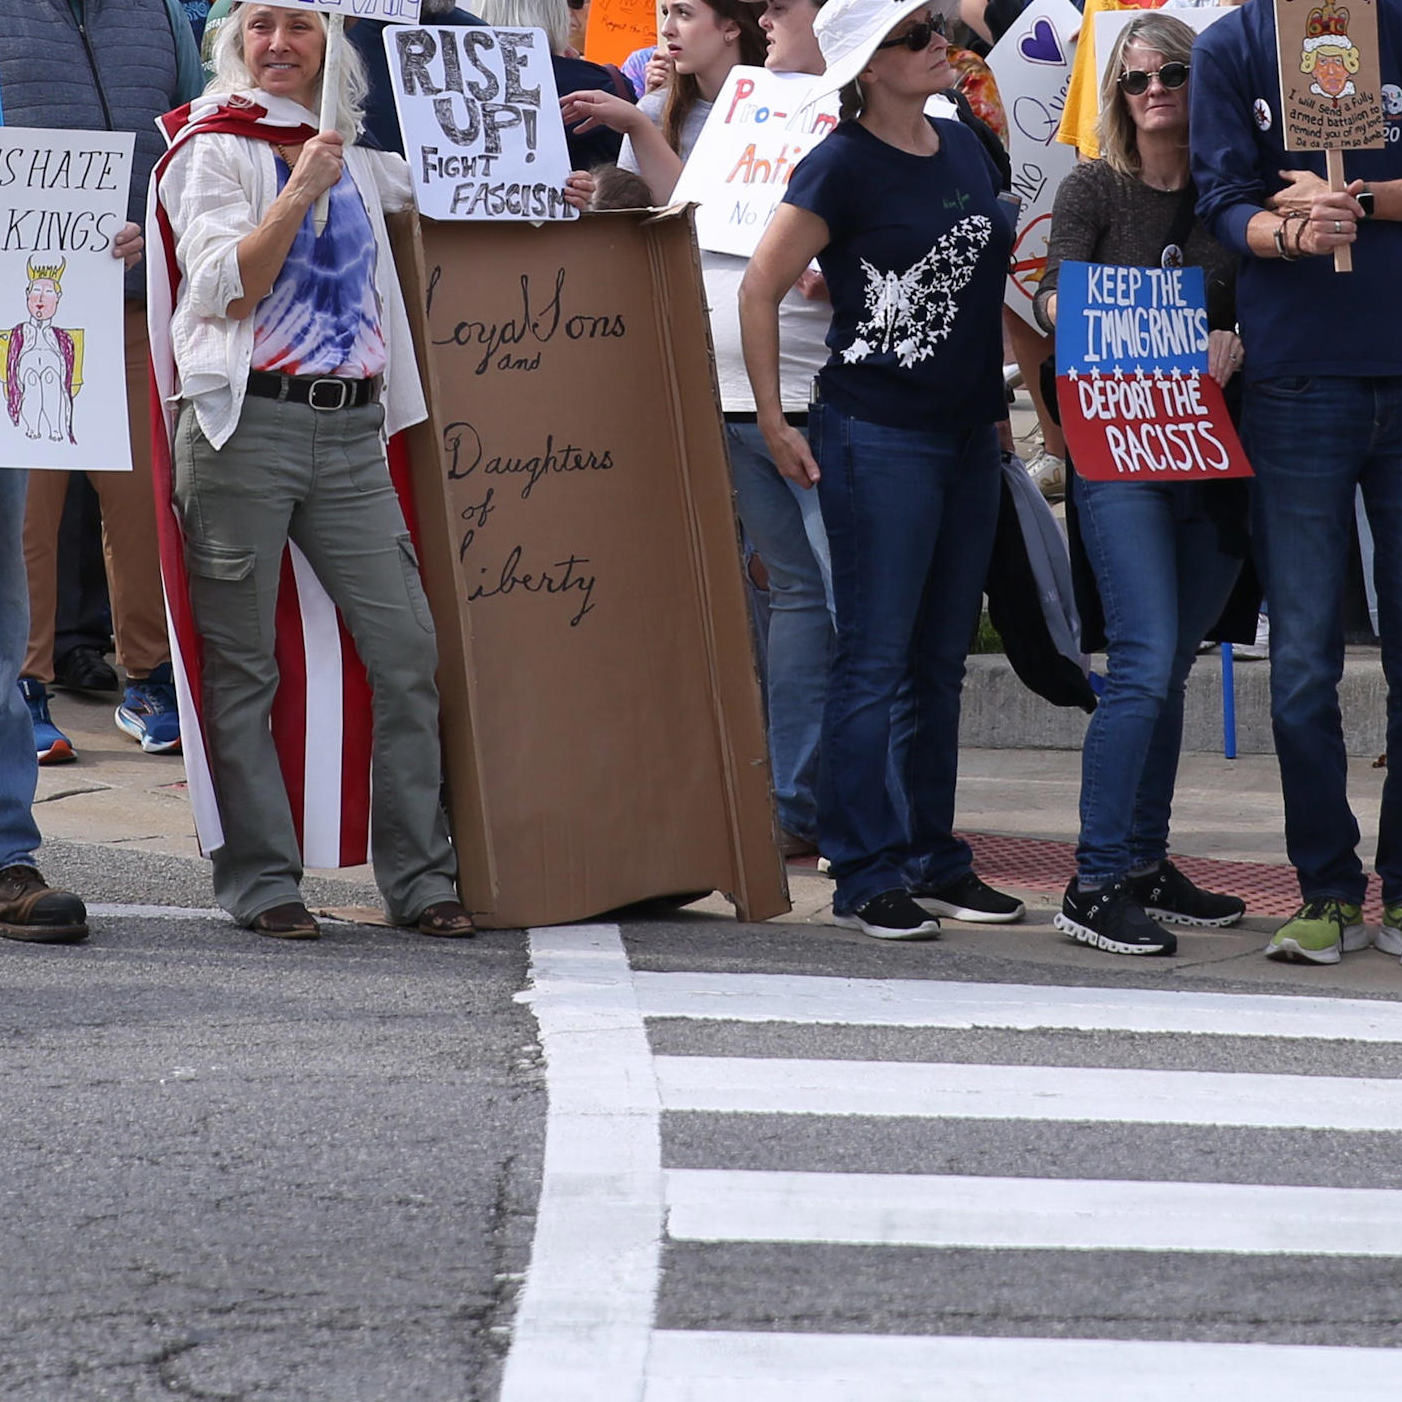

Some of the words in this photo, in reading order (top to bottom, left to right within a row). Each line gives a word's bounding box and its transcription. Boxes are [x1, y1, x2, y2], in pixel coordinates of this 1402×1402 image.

[395, 29, 542, 108] RISE
[725, 78, 838, 135] Pro-Am
[1288, 89, 1296, 100] I
[1298, 98, 1316, 109] will
[1344, 103, 1351, 111] a
[1289, 108, 1323, 126] armed
[1327, 110, 1369, 127] battalion
[1369, 106, 1379, 115] to
[433, 97, 538, 164] UP!
[1289, 123, 1322, 138] remind
[1325, 131, 1341, 140] you
[1343, 128, 1354, 137] of
[1354, 125, 1366, 135] my
[26, 148, 124, 191] HATE
[422, 145, 499, 184] FIGHT
[1012, 162, 1043, 200] NO
[450, 182, 575, 219] FASCISM
[729, 200, 757, 225] No
[0, 207, 118, 253] KINGS
[1087, 266, 1141, 306] KEEP
[1146, 269, 1187, 308] THE
[1083, 306, 1209, 362] IMMIGRANTS
[497, 351, 541, 372] and
[1078, 379, 1156, 420] DEPORT
[1156, 378, 1209, 418] THE
[443, 422, 615, 499] Daughters
[1105, 421, 1230, 473] RACISTS
[461, 487, 497, 524] of
